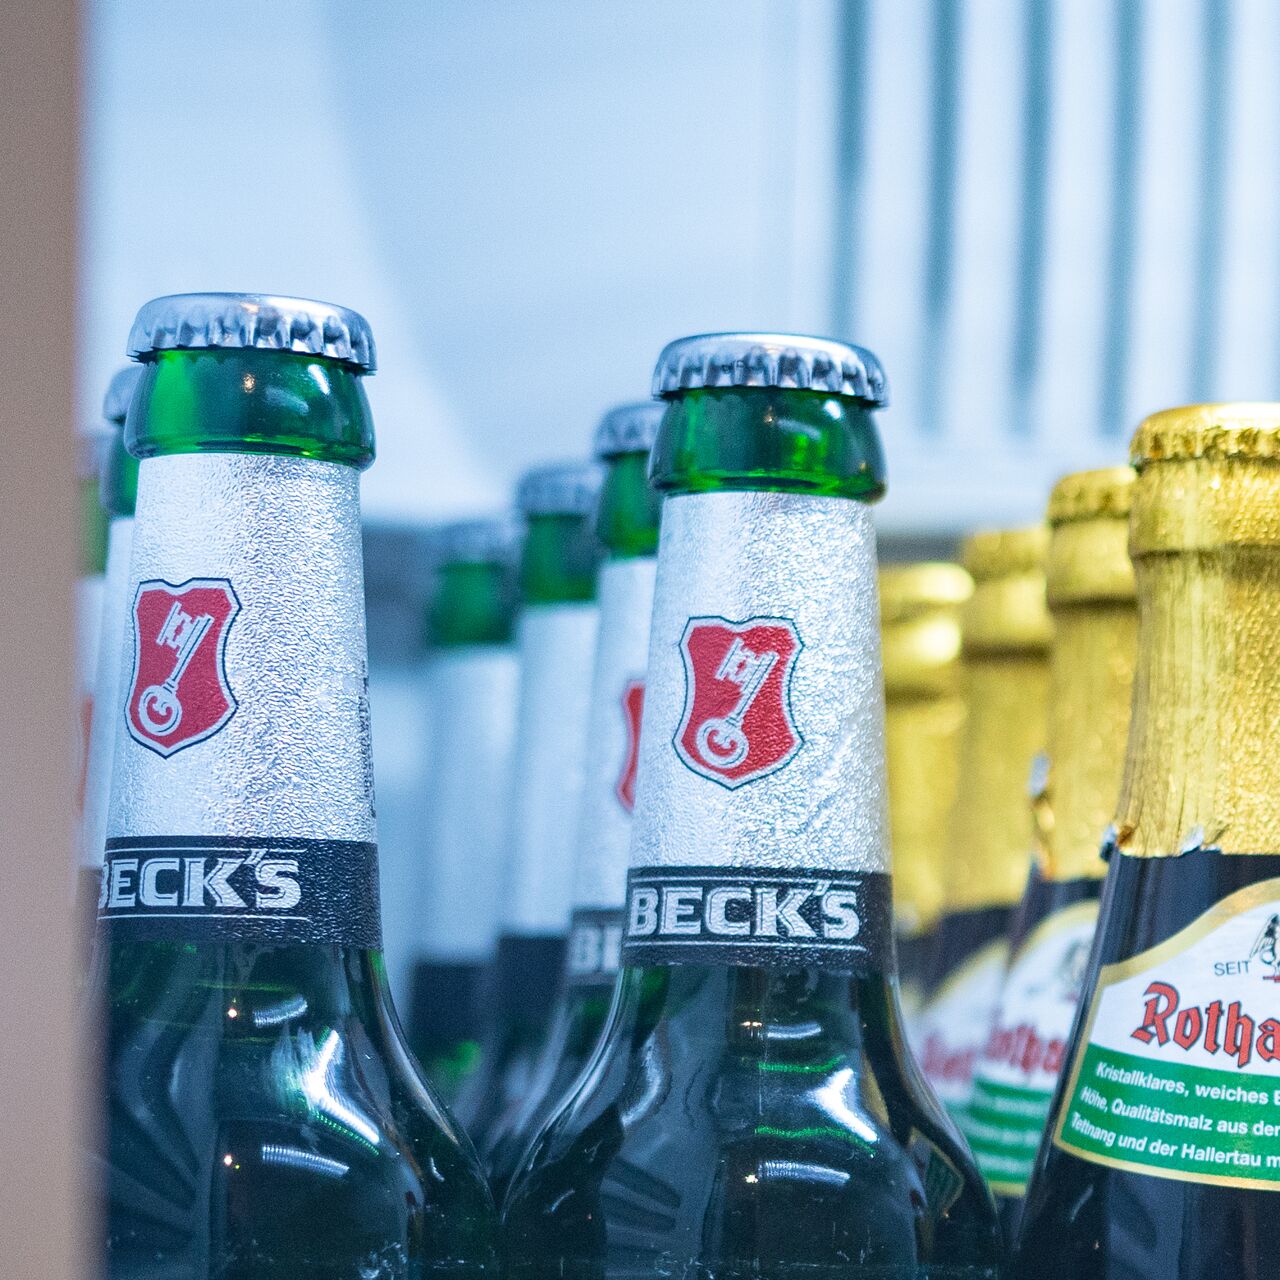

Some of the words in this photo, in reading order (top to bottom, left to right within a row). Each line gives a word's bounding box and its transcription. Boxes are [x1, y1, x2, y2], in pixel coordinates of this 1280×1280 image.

[627, 880, 861, 941] BECK'S
[1213, 960, 1252, 977] SEIT
[1096, 1062, 1190, 1097] Kristallklares,
[1195, 1084, 1269, 1105] weiches
[1080, 1086, 1108, 1112] Höhe,
[1111, 1098, 1213, 1132] Qualitätsmalz
[1216, 1119, 1248, 1135] aus
[1071, 1112, 1116, 1146] Tettnang
[1118, 1136, 1147, 1152] und
[1149, 1139, 1179, 1157] der
[1181, 1143, 1262, 1167] Hallertau
